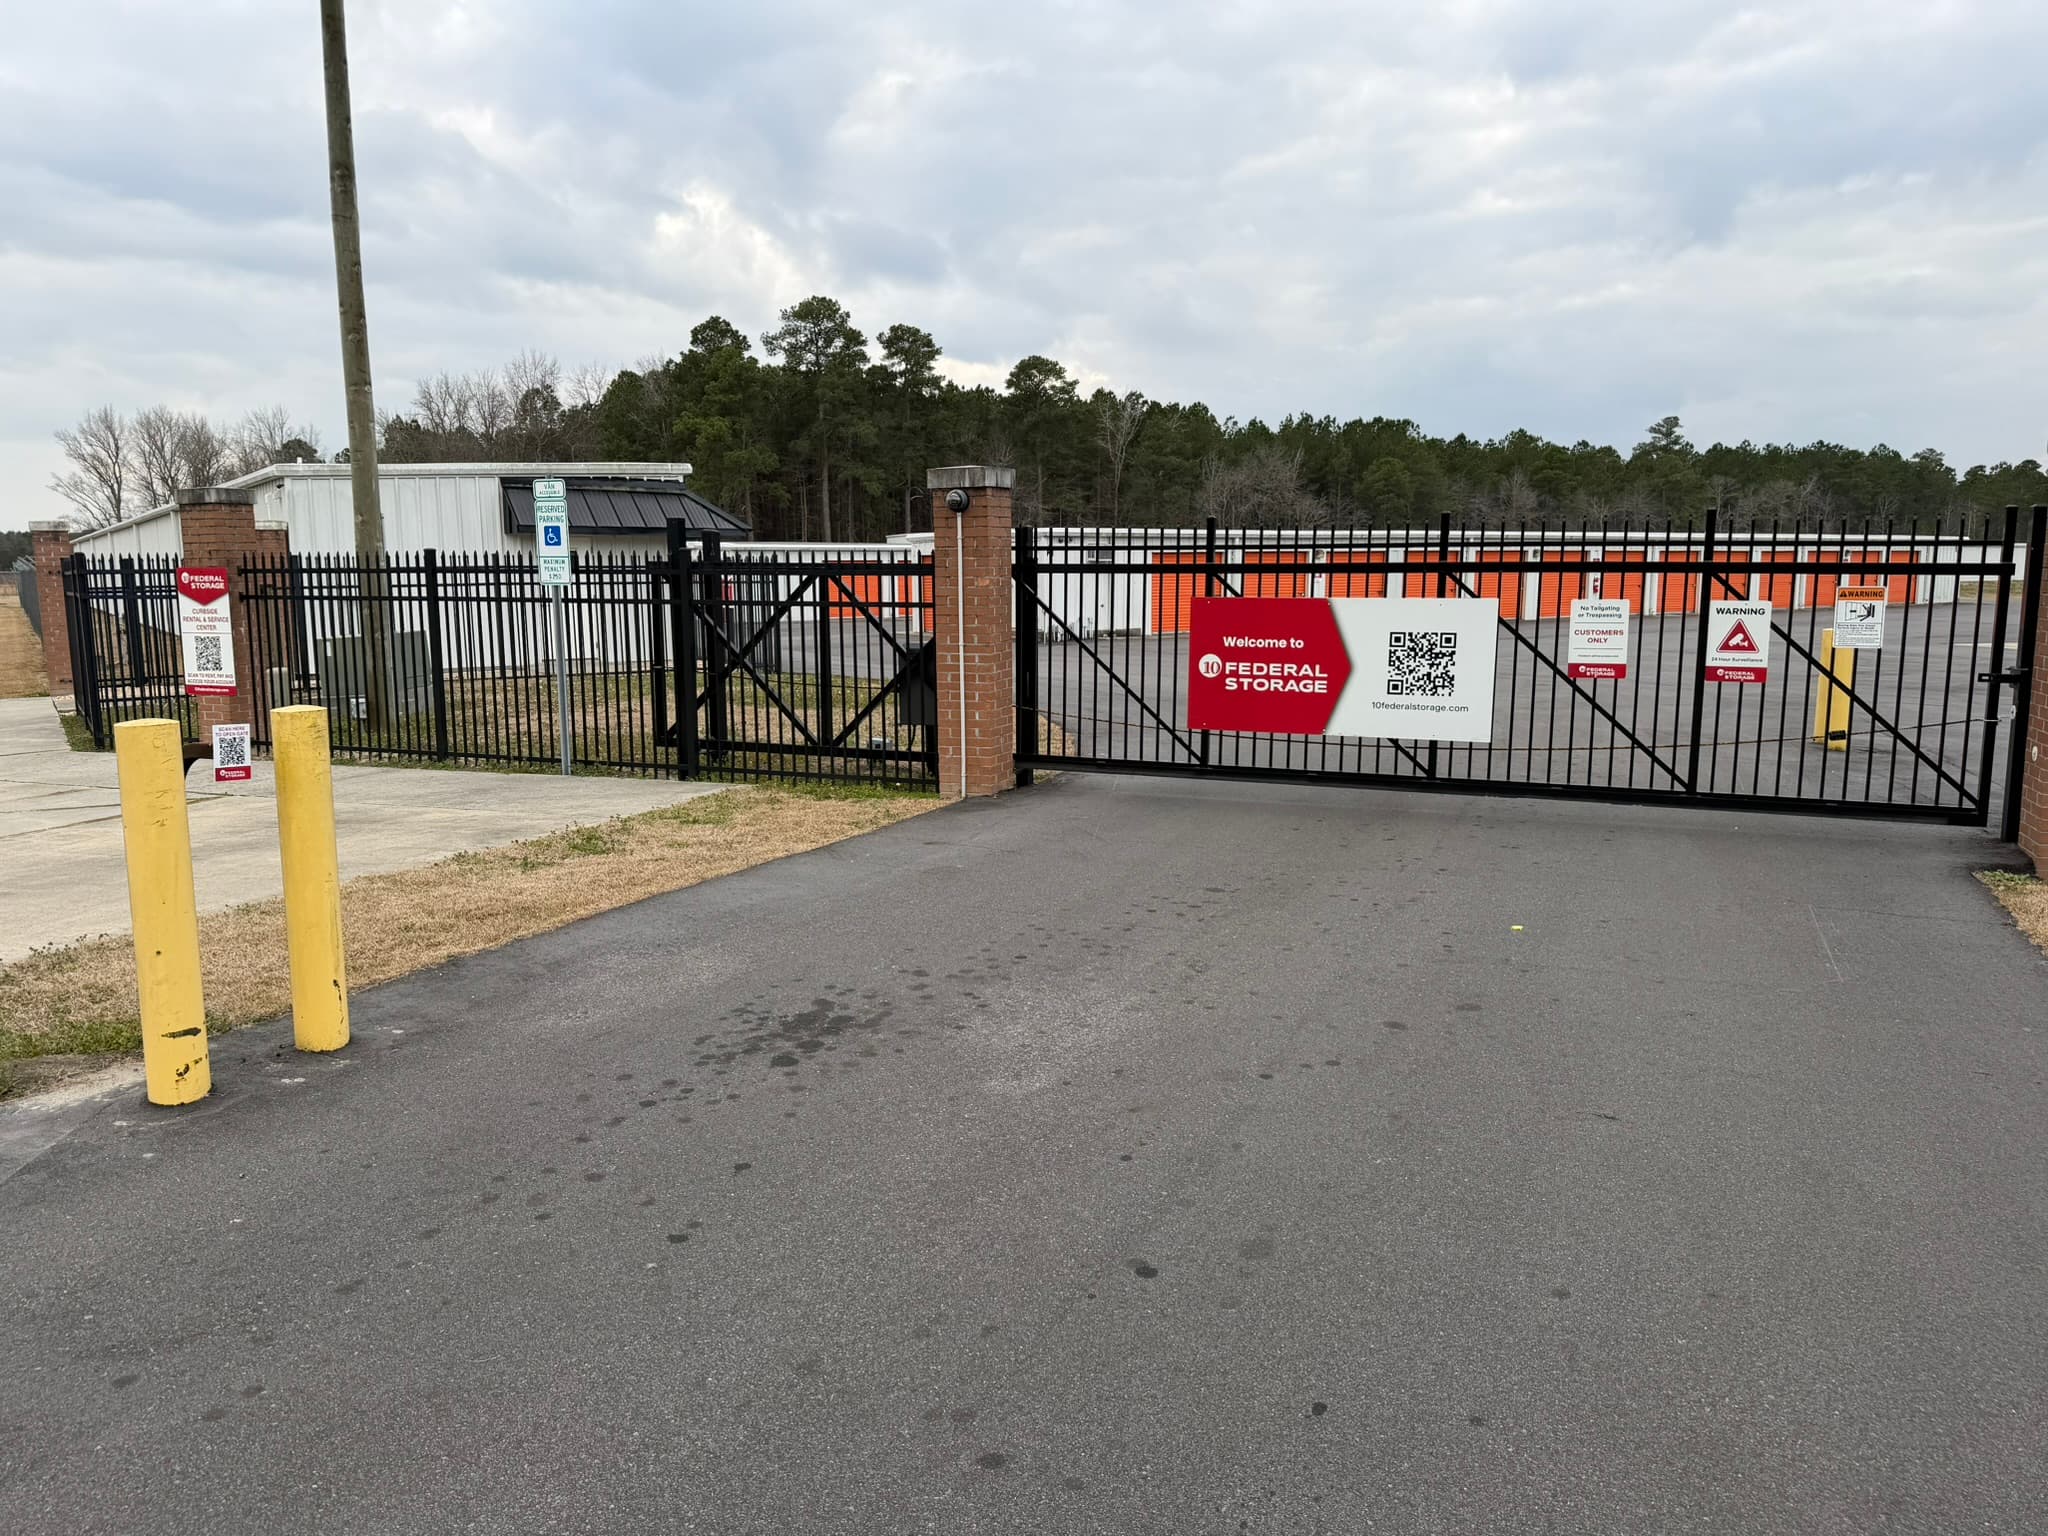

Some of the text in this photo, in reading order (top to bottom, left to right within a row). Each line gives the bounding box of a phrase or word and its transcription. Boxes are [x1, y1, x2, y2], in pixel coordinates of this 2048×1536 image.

[537, 505, 564, 513] RESERVED
[539, 515, 565, 523] PARKING
[191, 582, 225, 590] STORAGE
[1716, 607, 1766, 615] WARNING
[1223, 635, 1304, 649] Welcome to
[1225, 661, 1328, 678] FEDERAL
[1225, 677, 1328, 694] STORAGE
[1371, 701, 1469, 713] 10federalstorage.com
